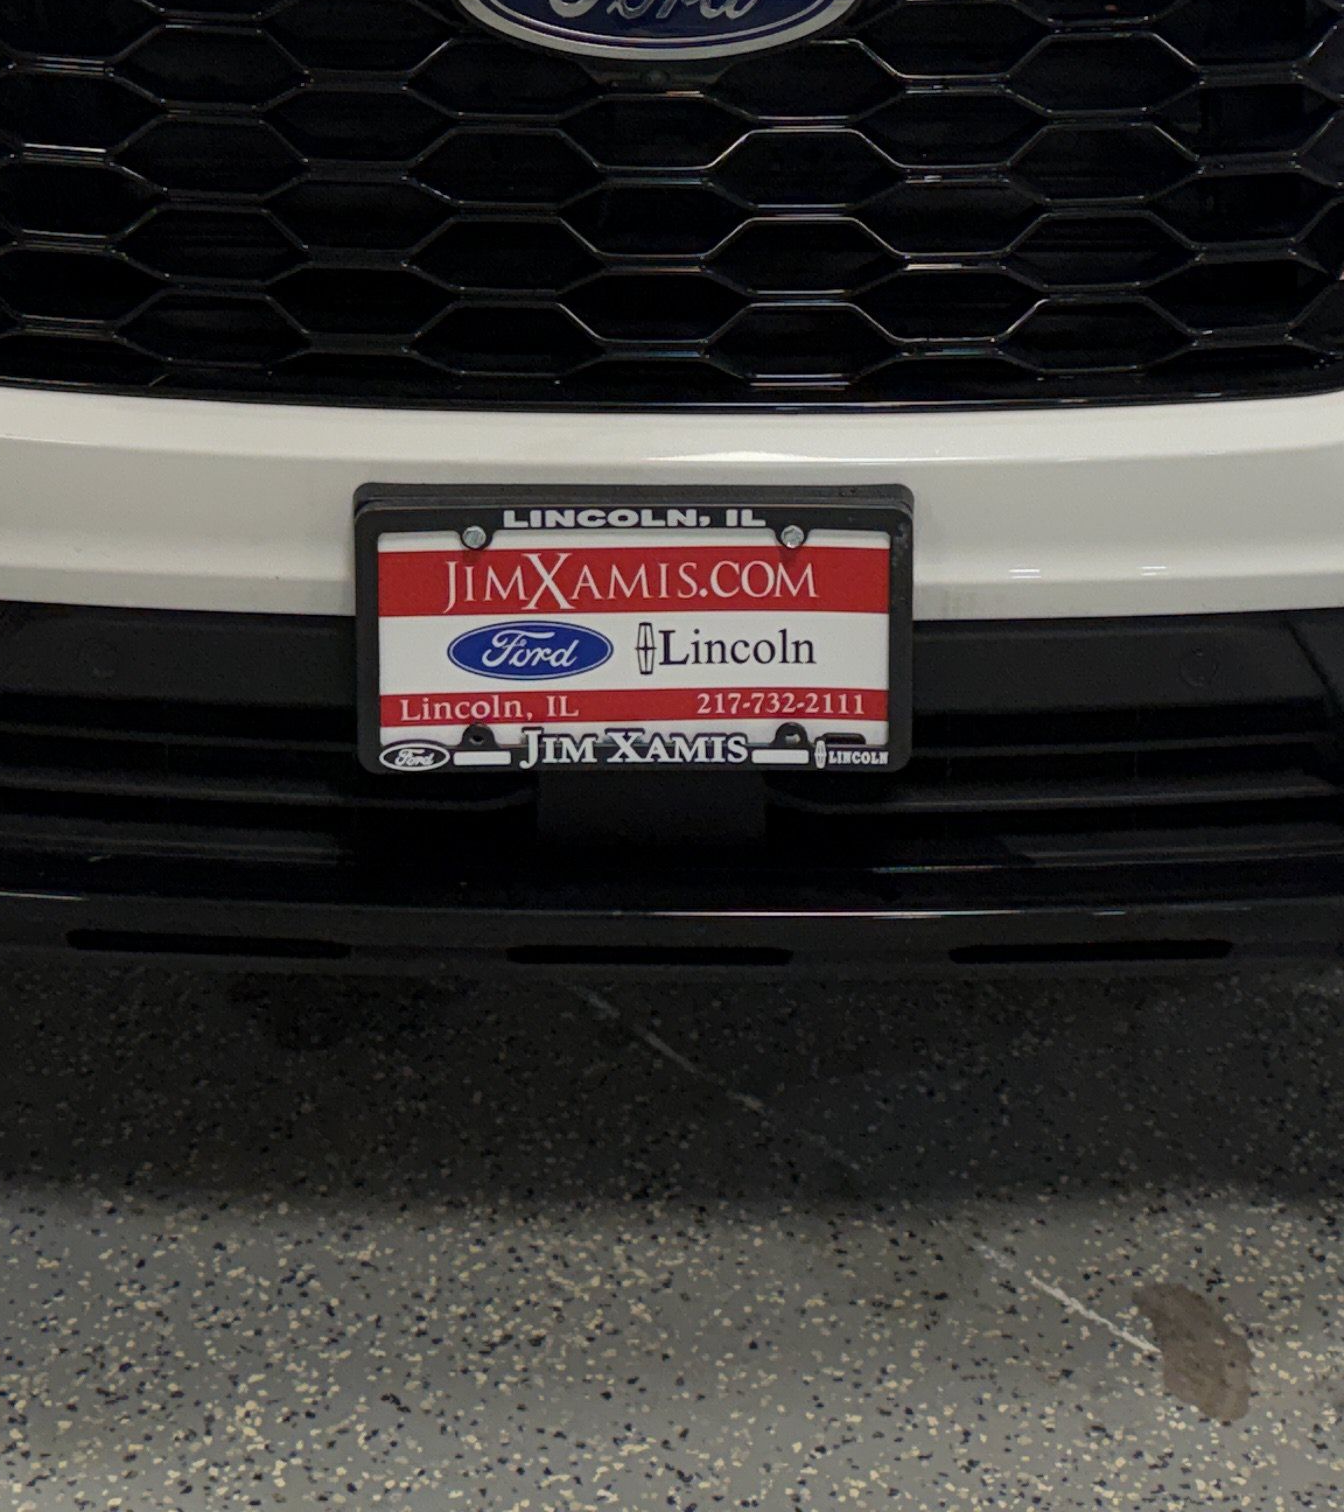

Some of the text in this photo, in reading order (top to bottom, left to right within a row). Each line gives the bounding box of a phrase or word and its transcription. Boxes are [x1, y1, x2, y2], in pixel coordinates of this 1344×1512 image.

[503, 508, 766, 528] LINCOLN, IL
[481, 629, 579, 668] Ford
[658, 628, 817, 666] Lincoln
[400, 694, 580, 721] Lincoln, IL
[697, 692, 865, 714] 217-732-2111
[394, 748, 435, 767] Ford
[519, 729, 749, 770] JIM XAMIS
[828, 751, 889, 765] LINCOLN
